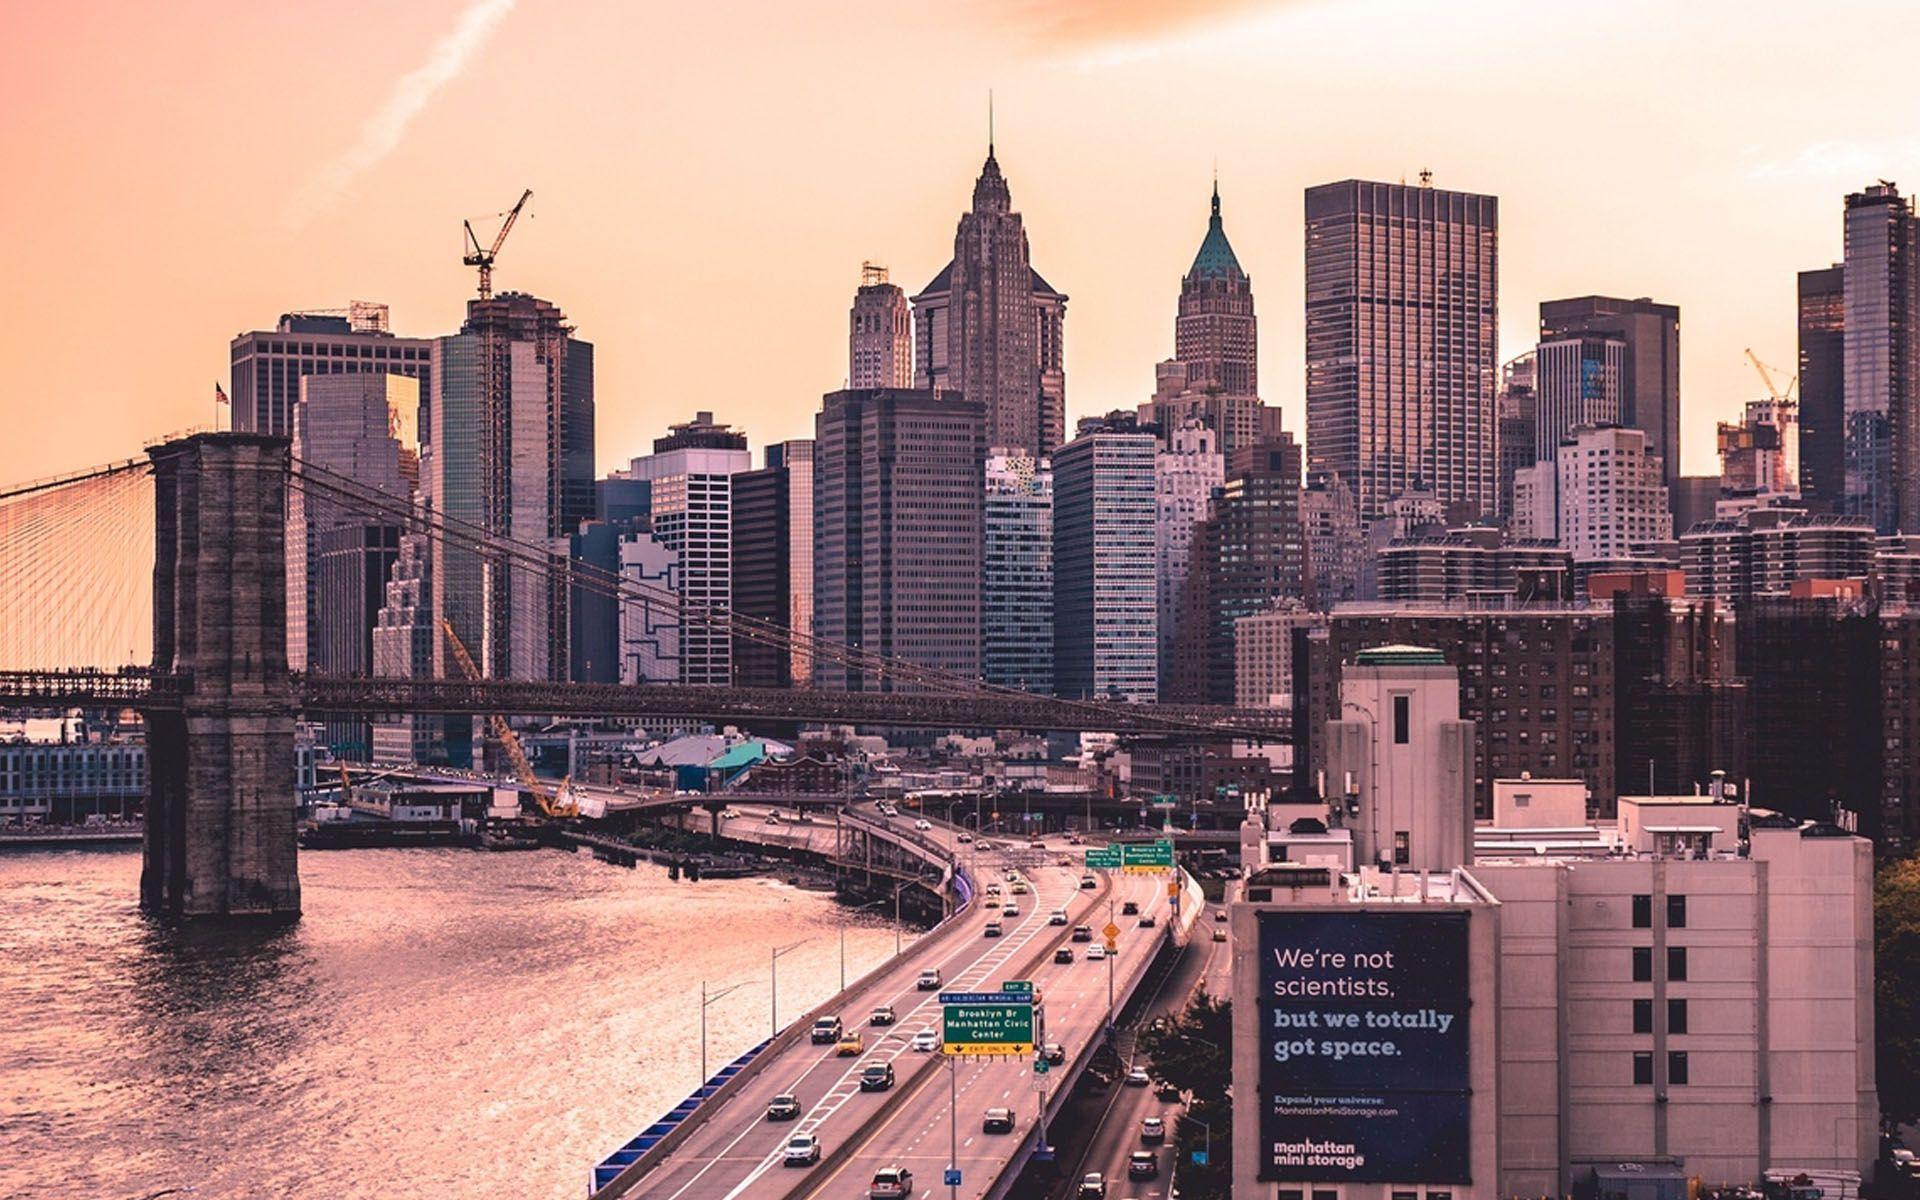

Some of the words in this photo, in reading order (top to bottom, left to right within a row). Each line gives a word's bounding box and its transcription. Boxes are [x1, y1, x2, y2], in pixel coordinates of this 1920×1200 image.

[1274, 948, 1346, 968] We're
[1354, 950, 1394, 968] not
[1274, 976, 1395, 998] scientists,
[958, 1010, 1002, 1019] Brooklyn
[1274, 1009, 1319, 1028] but
[1323, 1013, 1360, 1028] we
[1365, 1009, 1454, 1033] totally
[947, 1020, 1001, 1028] Manhattan
[1004, 1020, 1029, 1028] Civic
[971, 1030, 1005, 1039] Center
[1274, 1038, 1316, 1061] got
[1321, 1041, 1402, 1060] space.
[1274, 1095, 1313, 1106] Expand
[1314, 1097, 1336, 1106] your
[1338, 1095, 1385, 1105] universe:
[1274, 1106, 1398, 1118] ManhattanMiniStorage.com
[1274, 1136, 1355, 1155] manhattan
[1274, 1154, 1303, 1166] mini
[1307, 1155, 1364, 1170] storage
